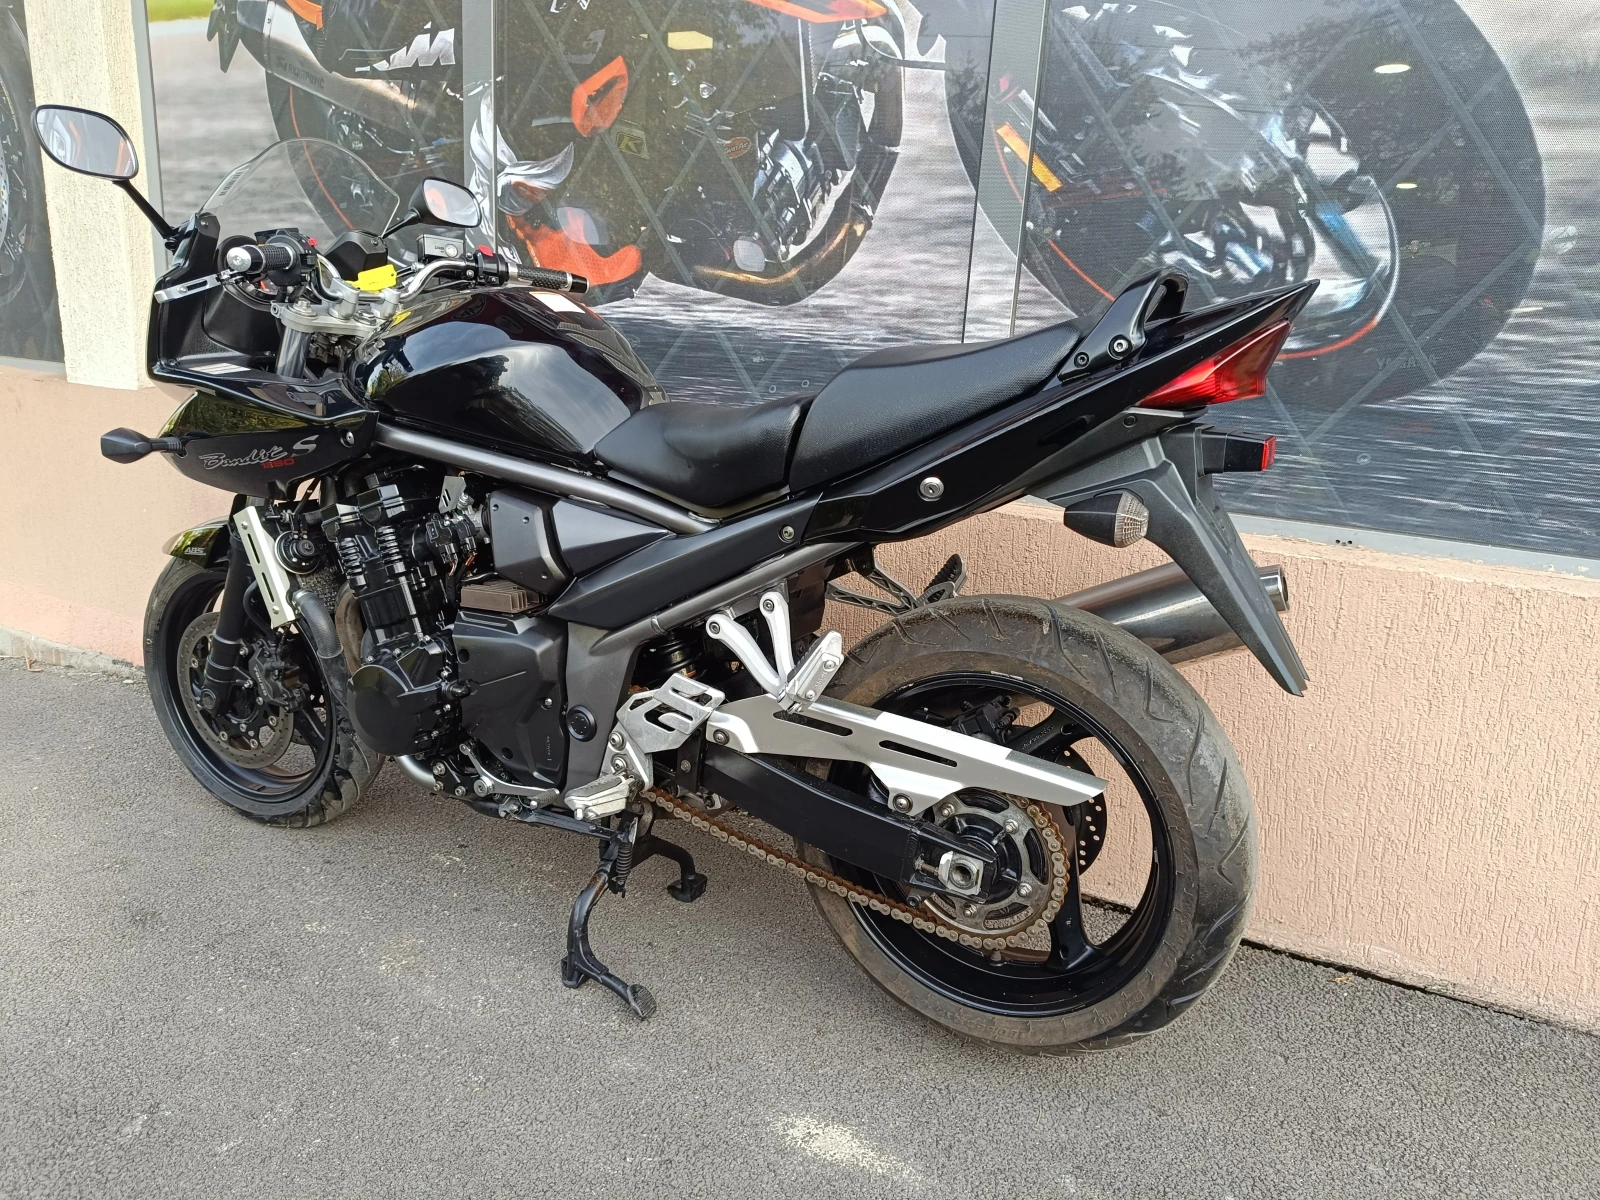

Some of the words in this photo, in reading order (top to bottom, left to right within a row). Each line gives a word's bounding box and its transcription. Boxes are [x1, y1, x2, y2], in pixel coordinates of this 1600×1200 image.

[199, 445, 288, 469] Bandit
[291, 435, 319, 457] S
[261, 457, 294, 469] 1250
[184, 546, 206, 556] ABS
